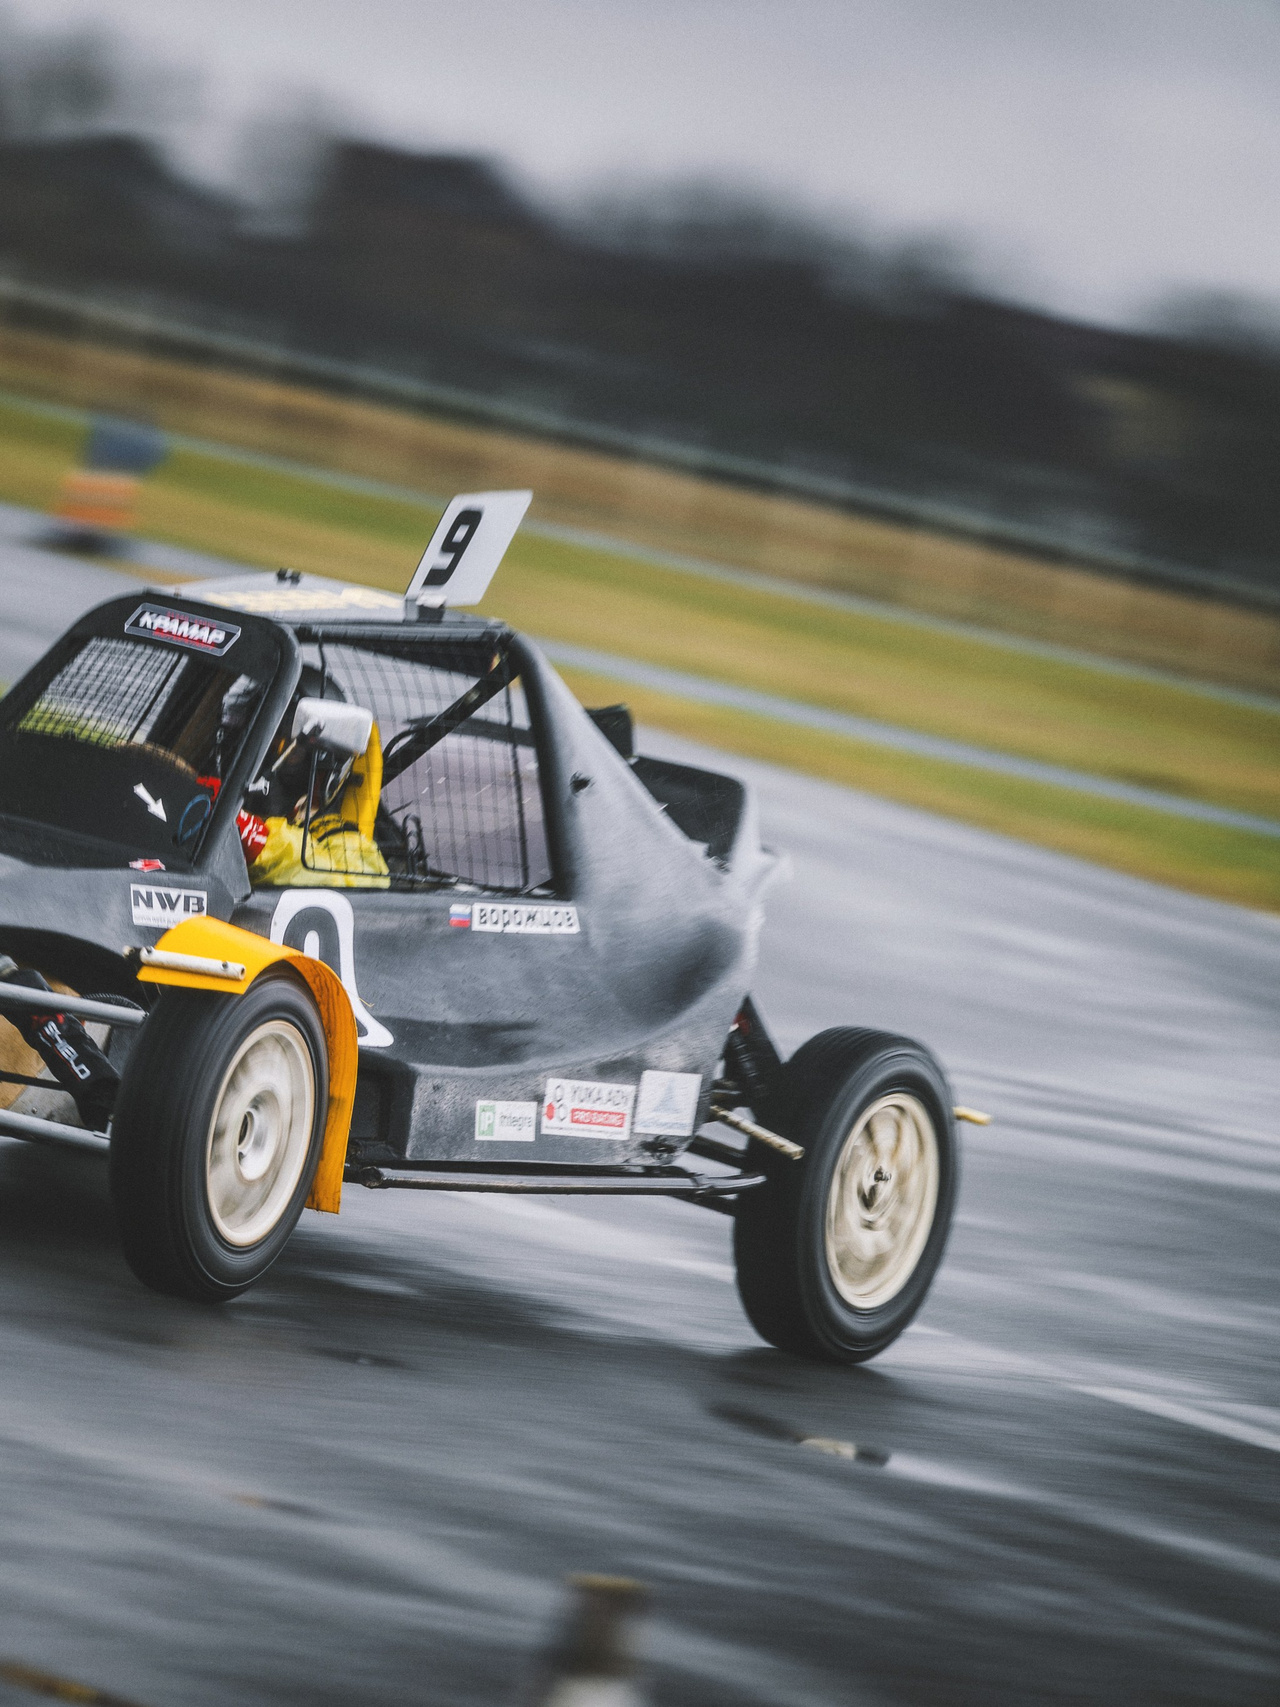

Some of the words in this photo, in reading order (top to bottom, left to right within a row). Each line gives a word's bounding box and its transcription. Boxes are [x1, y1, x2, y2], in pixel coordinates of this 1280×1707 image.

[420, 507, 483, 588] 9
[132, 889, 206, 913] NWB
[42, 1020, 92, 1080] SHIELD
